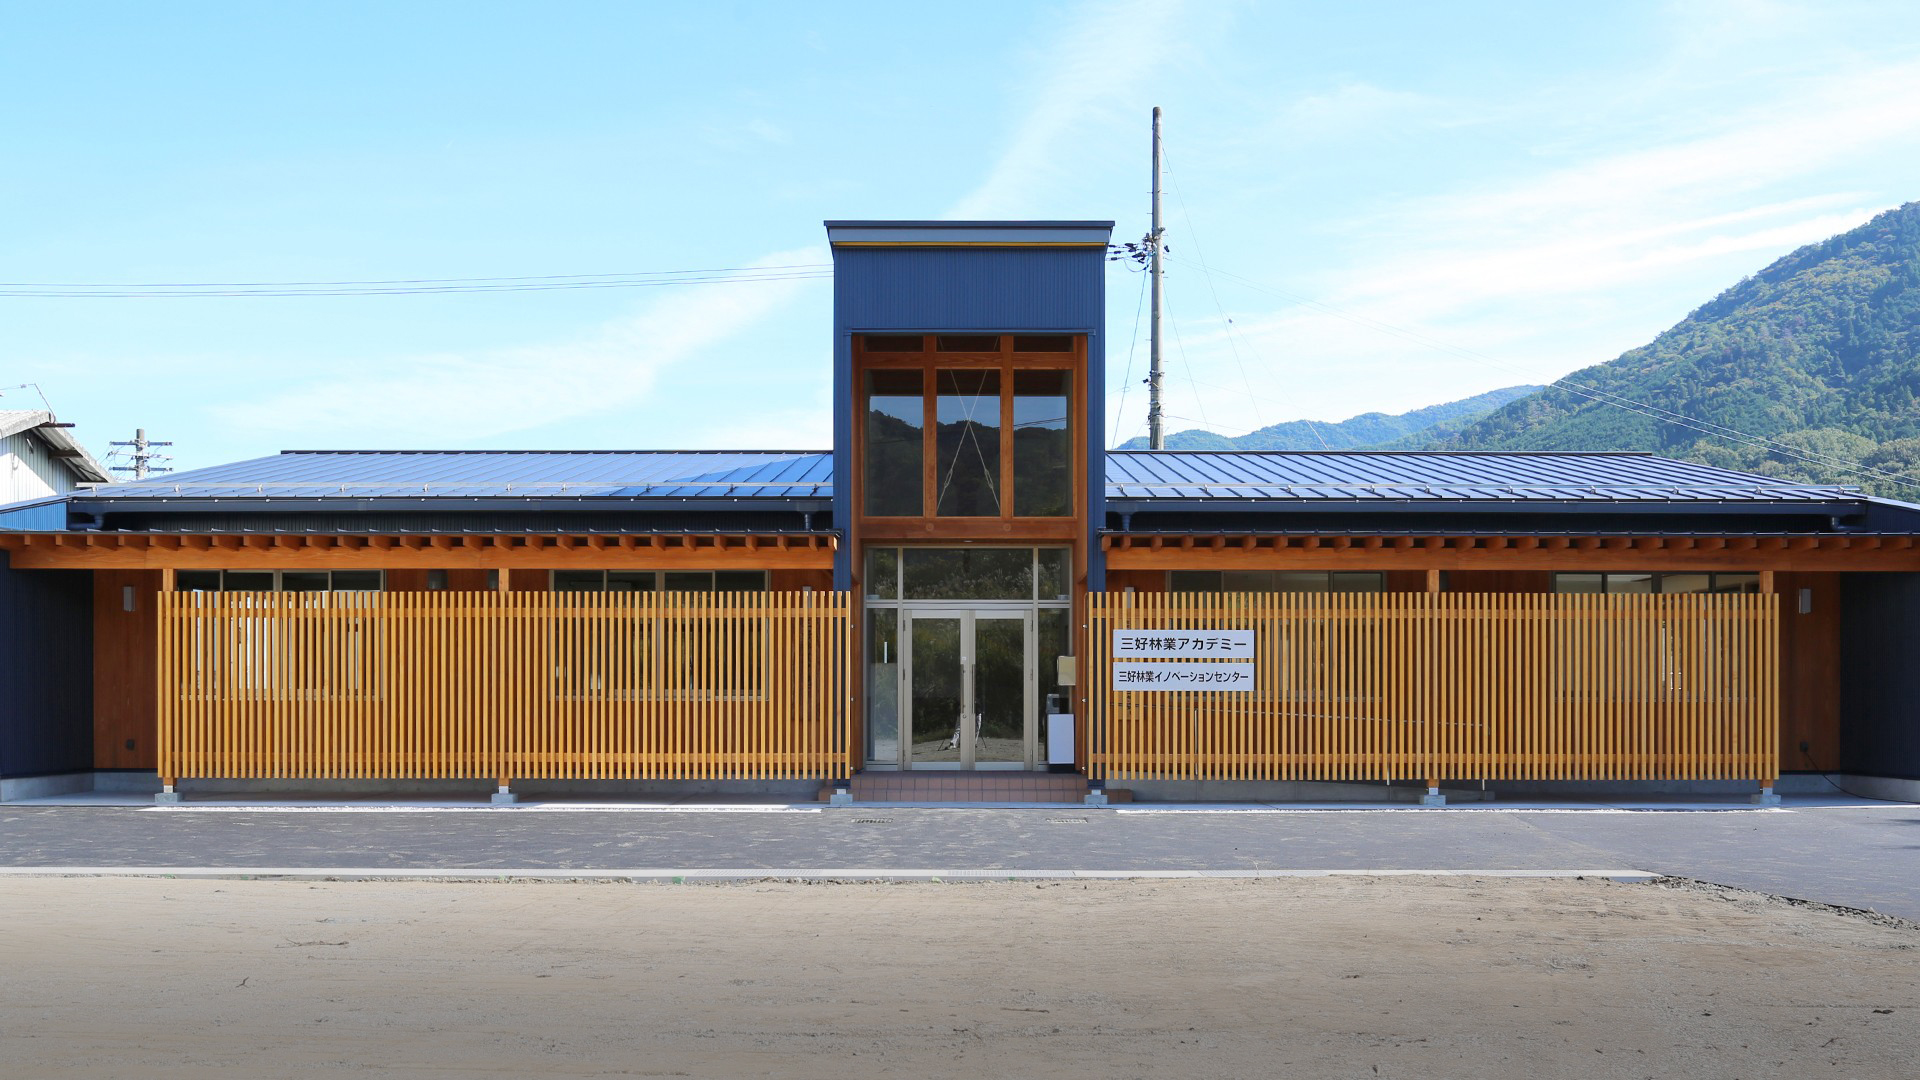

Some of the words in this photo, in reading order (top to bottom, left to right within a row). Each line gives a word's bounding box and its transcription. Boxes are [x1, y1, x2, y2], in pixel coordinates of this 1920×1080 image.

[1120, 637, 1247, 651] 三好林業アカデミー
[1118, 670, 1249, 683] 三好林業イノベーションセンター
